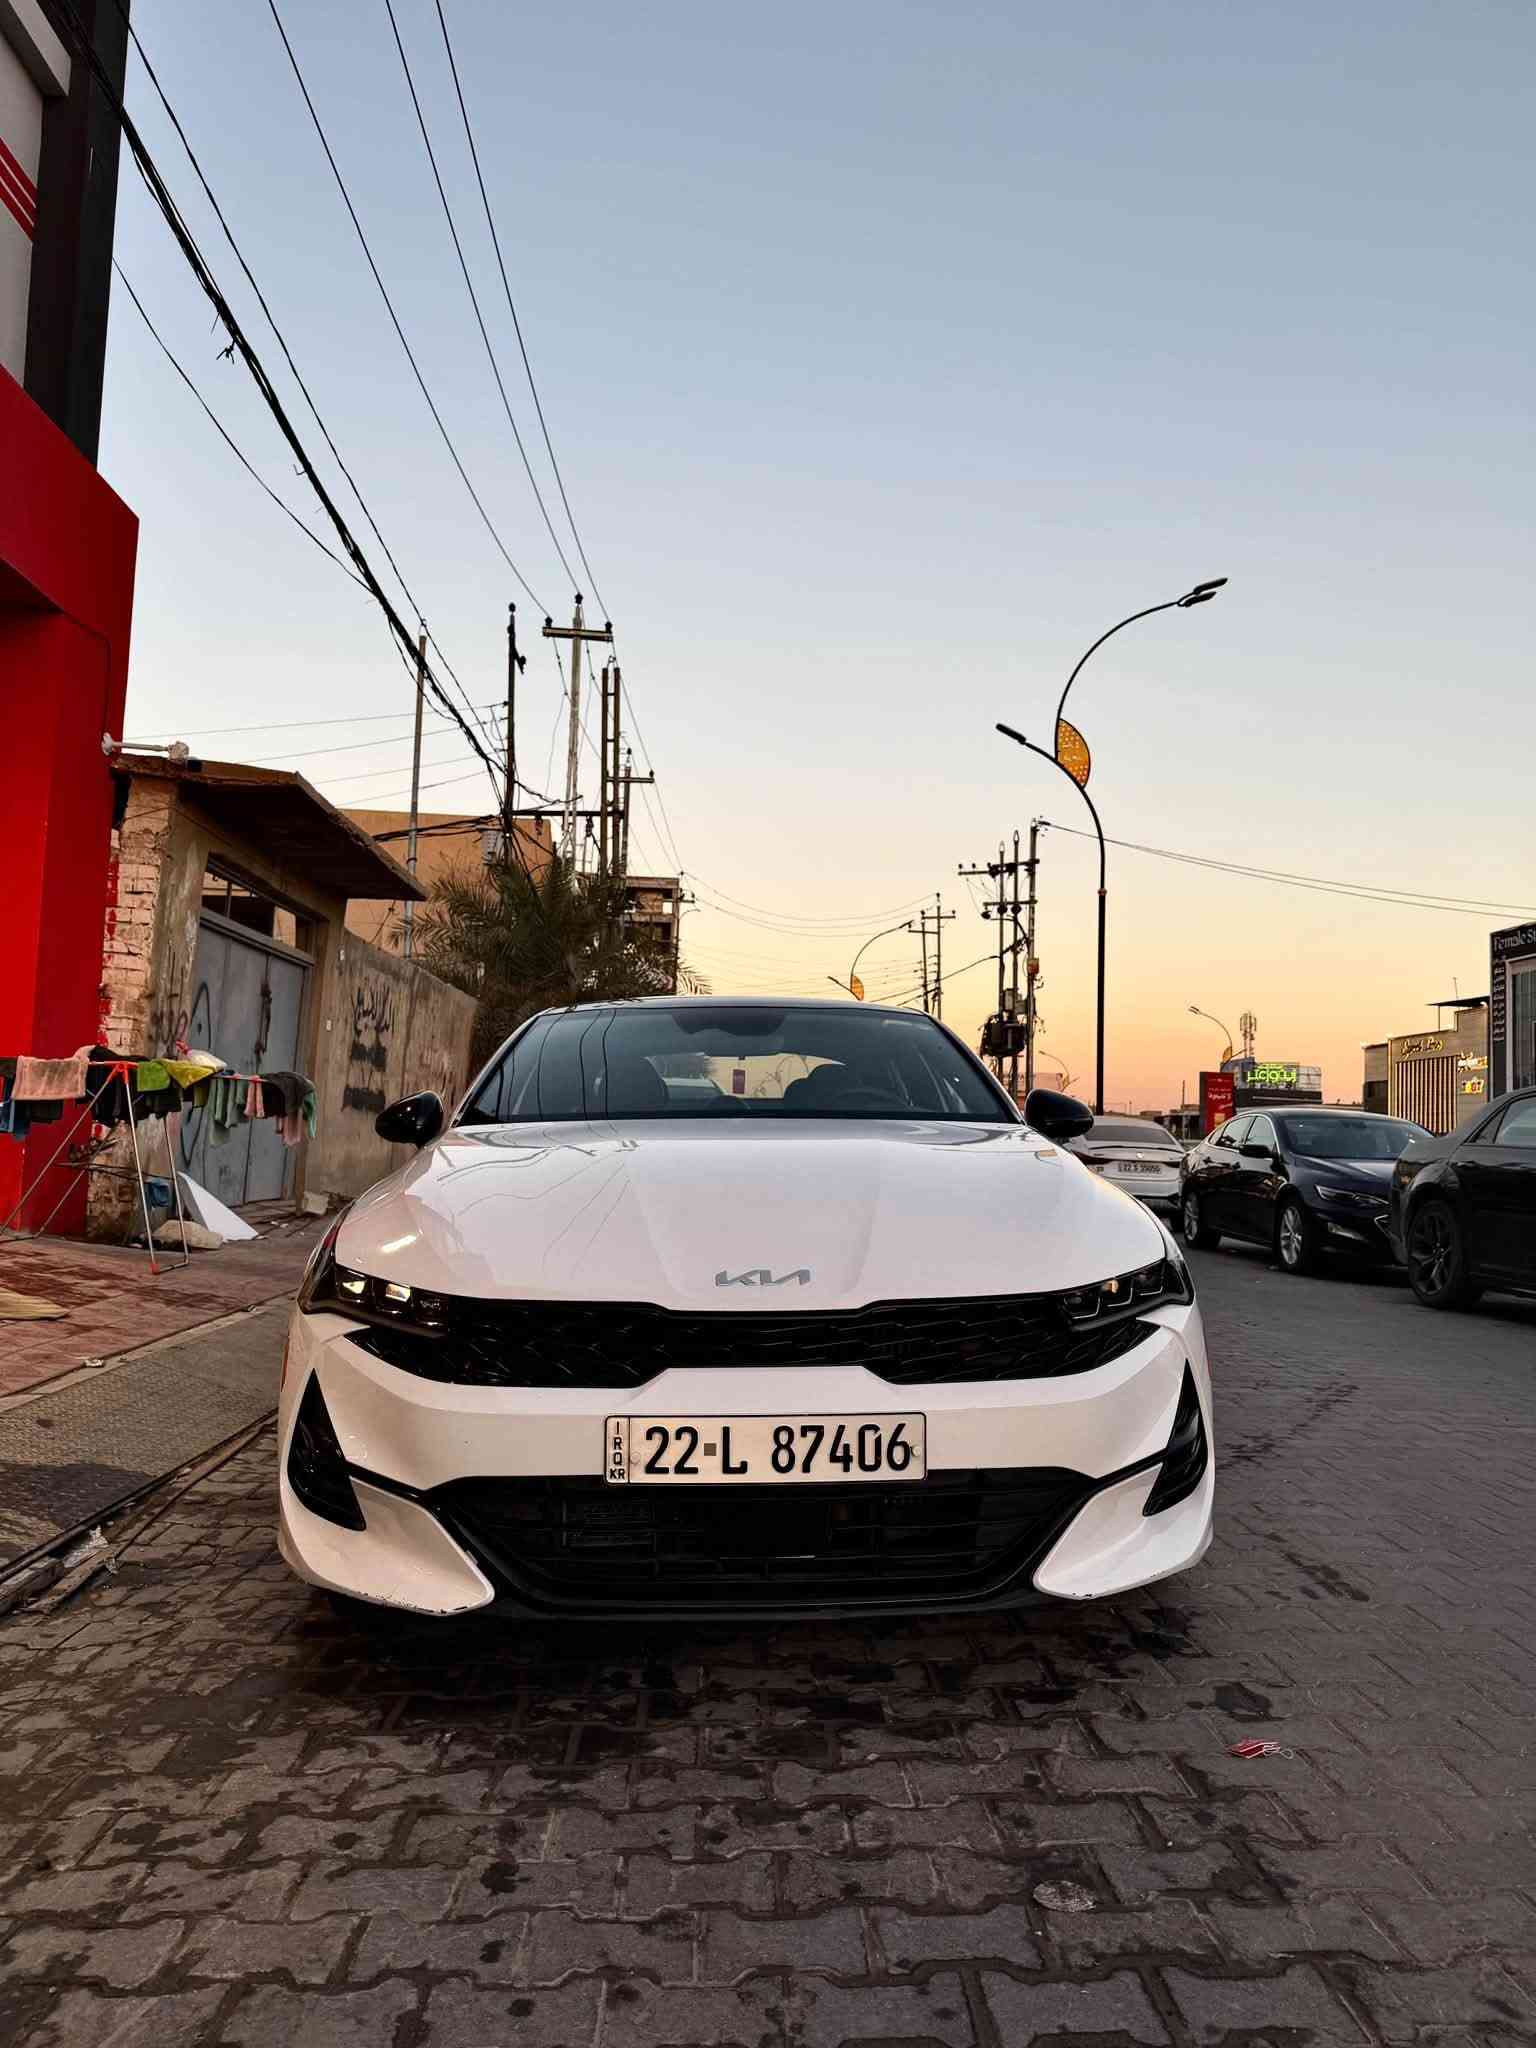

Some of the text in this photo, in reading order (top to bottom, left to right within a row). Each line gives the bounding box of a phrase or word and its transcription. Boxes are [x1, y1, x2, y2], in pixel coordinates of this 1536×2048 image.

[714, 1269, 811, 1287] KIA
[770, 1423, 912, 1474] 87406
[609, 1468, 625, 1480] KR
